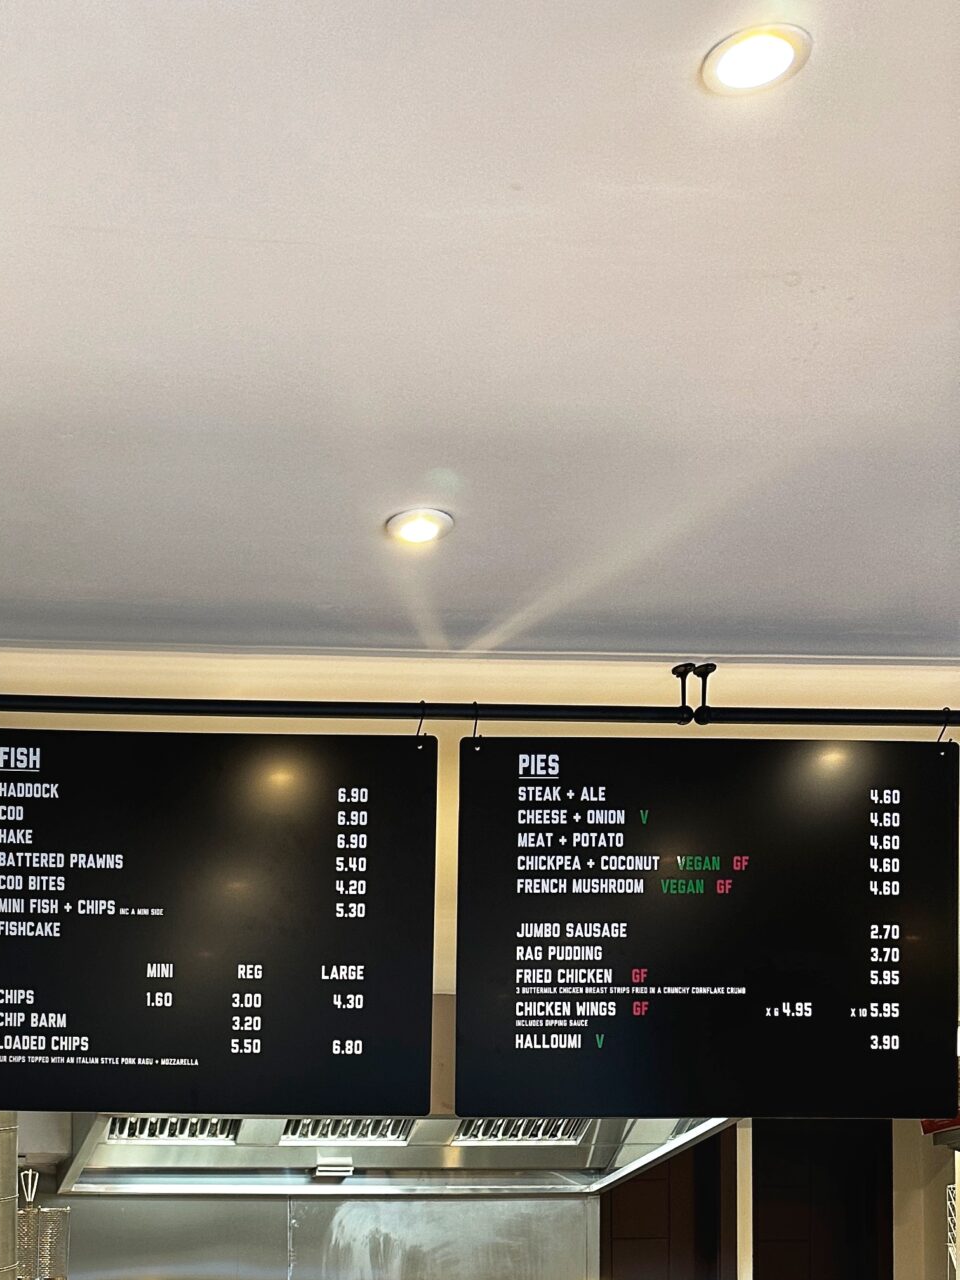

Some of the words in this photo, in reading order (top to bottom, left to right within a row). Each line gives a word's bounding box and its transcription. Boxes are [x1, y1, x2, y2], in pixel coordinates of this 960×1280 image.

[0, 747, 40, 768] FISH
[519, 754, 559, 775] PIES
[0, 783, 58, 798] HADDOCK
[338, 788, 368, 802] 6.90
[518, 787, 561, 801] STEAK
[567, 790, 574, 799] +
[581, 787, 605, 801] ALE
[871, 790, 900, 804] 4.60
[0, 806, 23, 820] COD
[338, 811, 367, 825] 6.90
[518, 810, 567, 824] CHEESE
[573, 813, 581, 822] +
[587, 810, 625, 824] ONION
[641, 810, 648, 823] V
[870, 812, 900, 827] 4.60
[0, 829, 32, 844] HAKE
[337, 834, 367, 848] 6.90
[518, 833, 553, 847] MEAT
[559, 836, 567, 845] +
[573, 833, 623, 847] POTATO
[870, 835, 899, 849] 4.60
[0, 852, 64, 867] BATTERED
[70, 854, 123, 869] PRAWNS
[336, 857, 366, 871] 5.40
[517, 856, 581, 870] CHICKPEA
[587, 859, 595, 868] +
[601, 856, 660, 870] COCONUT
[677, 856, 719, 870] VEGAN
[734, 856, 749, 870] GF
[870, 858, 899, 872] 4.60
[29, 876, 65, 890] BITES
[336, 880, 366, 894] 4.20
[517, 879, 566, 893] FRENCH
[572, 879, 643, 893] MUSHROOM
[661, 880, 703, 893] VEGAN
[717, 880, 732, 893] GF
[870, 881, 899, 895] 4.60
[30, 899, 58, 913] FISH
[64, 903, 72, 912] +
[78, 900, 115, 914] CHIPS
[336, 903, 365, 917] 5.30
[517, 923, 560, 937] JUMBO
[566, 923, 627, 937] SAUSAGE
[871, 925, 899, 939] 2.70
[517, 946, 542, 960] RAG
[548, 946, 602, 960] PUDDING
[871, 948, 899, 962] 3.70
[147, 963, 173, 977] MINI
[238, 964, 262, 979] REG
[322, 965, 364, 980] LARGE
[516, 969, 552, 983] FRIED
[558, 969, 612, 983] CHICKEN
[632, 969, 647, 982] GF
[871, 970, 899, 984] 5.95
[516, 986, 521, 995] 3
[657, 986, 661, 994] A
[147, 992, 172, 1006] 1.60
[232, 993, 261, 1008] 3.00
[333, 994, 363, 1008] 4.30
[516, 1002, 570, 1016] CHICKEN
[576, 1002, 616, 1016] WINGS
[633, 1002, 648, 1015] GF
[774, 1008, 779, 1016] 6
[783, 1002, 812, 1017] 4.95
[859, 1008, 867, 1017] 10
[870, 1003, 899, 1017] 5.95
[31, 1013, 66, 1027] BARM
[232, 1016, 261, 1030] 3.20
[51, 1036, 88, 1051] CHIPS
[231, 1039, 260, 1053] 5.50
[333, 1040, 362, 1054] 6.80
[516, 1034, 581, 1048] HALLOUMI
[596, 1035, 604, 1048] V
[871, 1035, 899, 1049] 3.90
